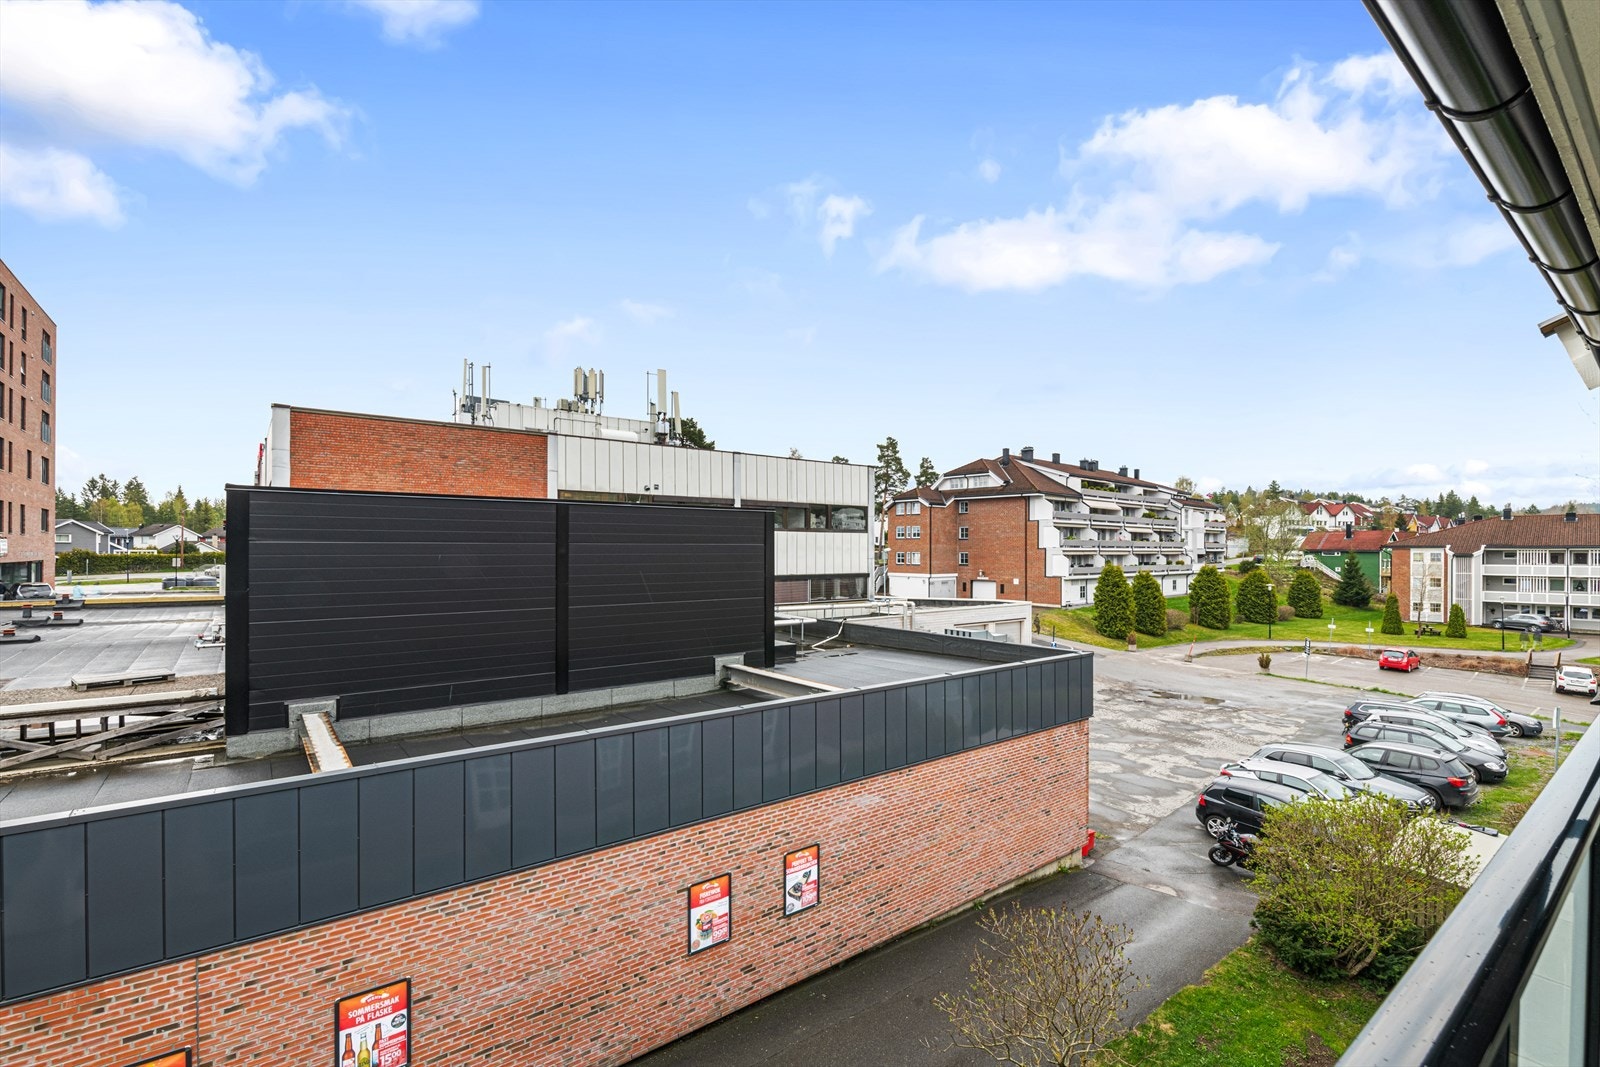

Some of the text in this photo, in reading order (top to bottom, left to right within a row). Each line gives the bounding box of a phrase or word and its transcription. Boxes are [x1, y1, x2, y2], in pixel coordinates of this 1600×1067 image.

[348, 995, 400, 1019] SOMMERSMAK
[355, 1014, 365, 1025] PÅ
[367, 1006, 393, 1022] FLASKE
